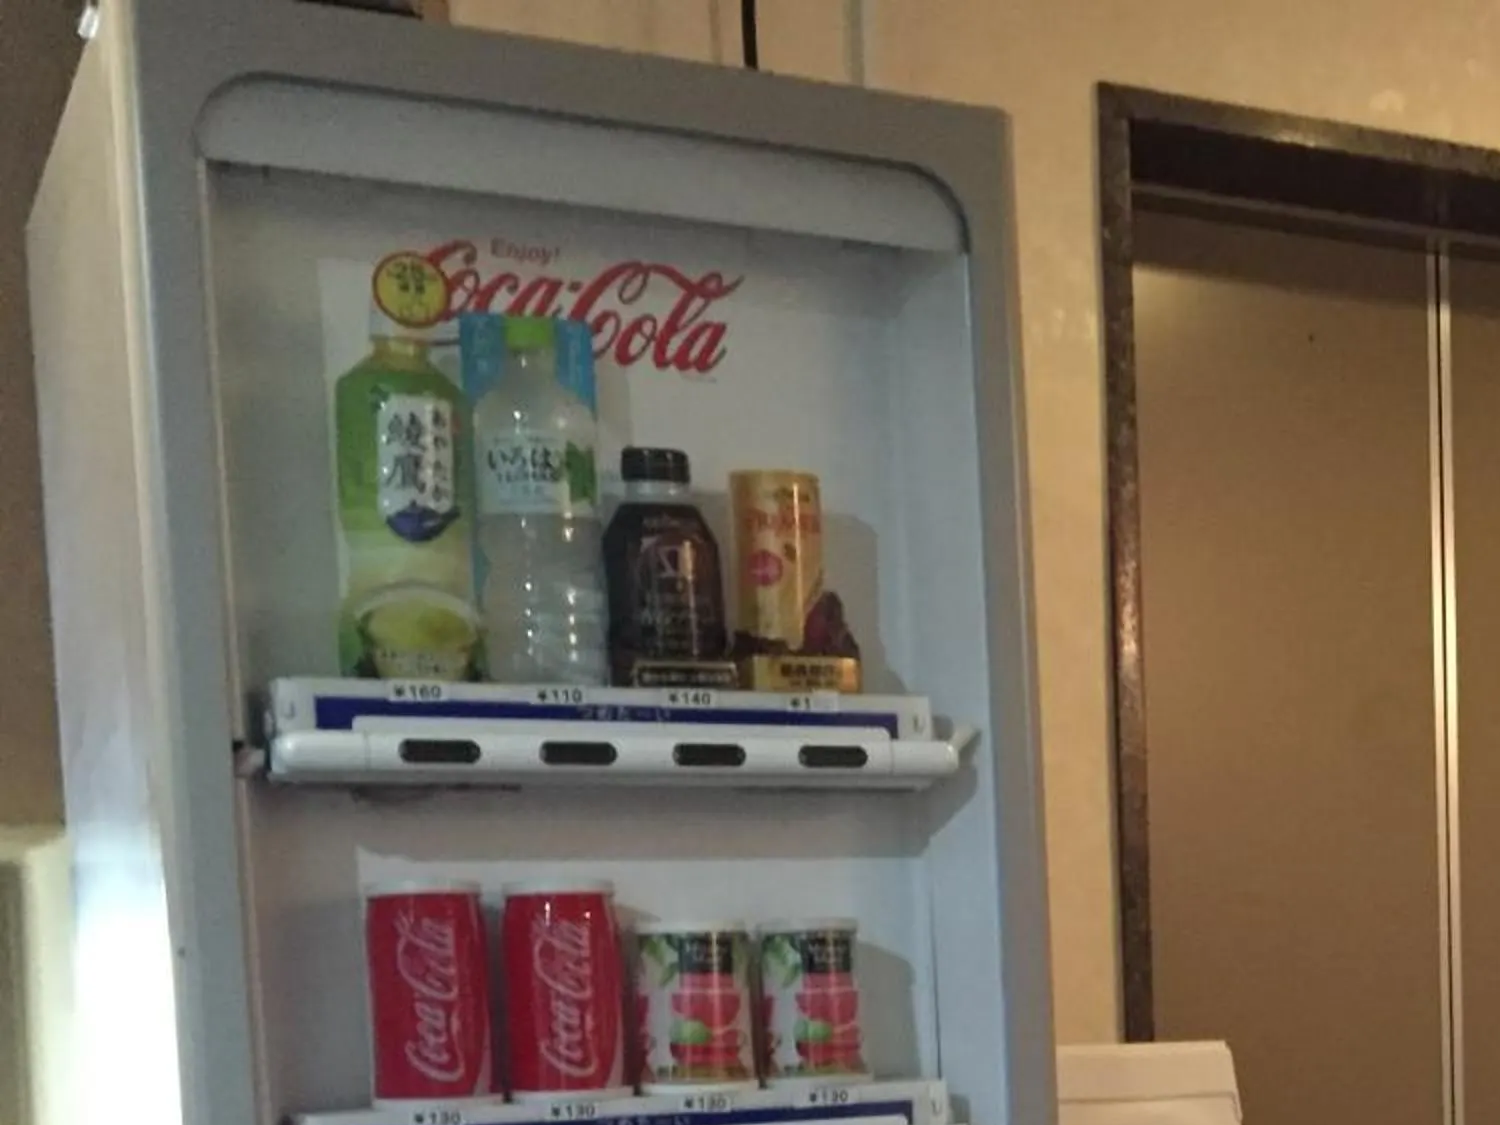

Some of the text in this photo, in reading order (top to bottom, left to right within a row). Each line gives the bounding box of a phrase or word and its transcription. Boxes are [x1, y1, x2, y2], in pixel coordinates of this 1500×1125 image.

[490, 237, 561, 264] Enjoy!
[394, 683, 442, 702] ¥160
[537, 689, 583, 705] ¥110
